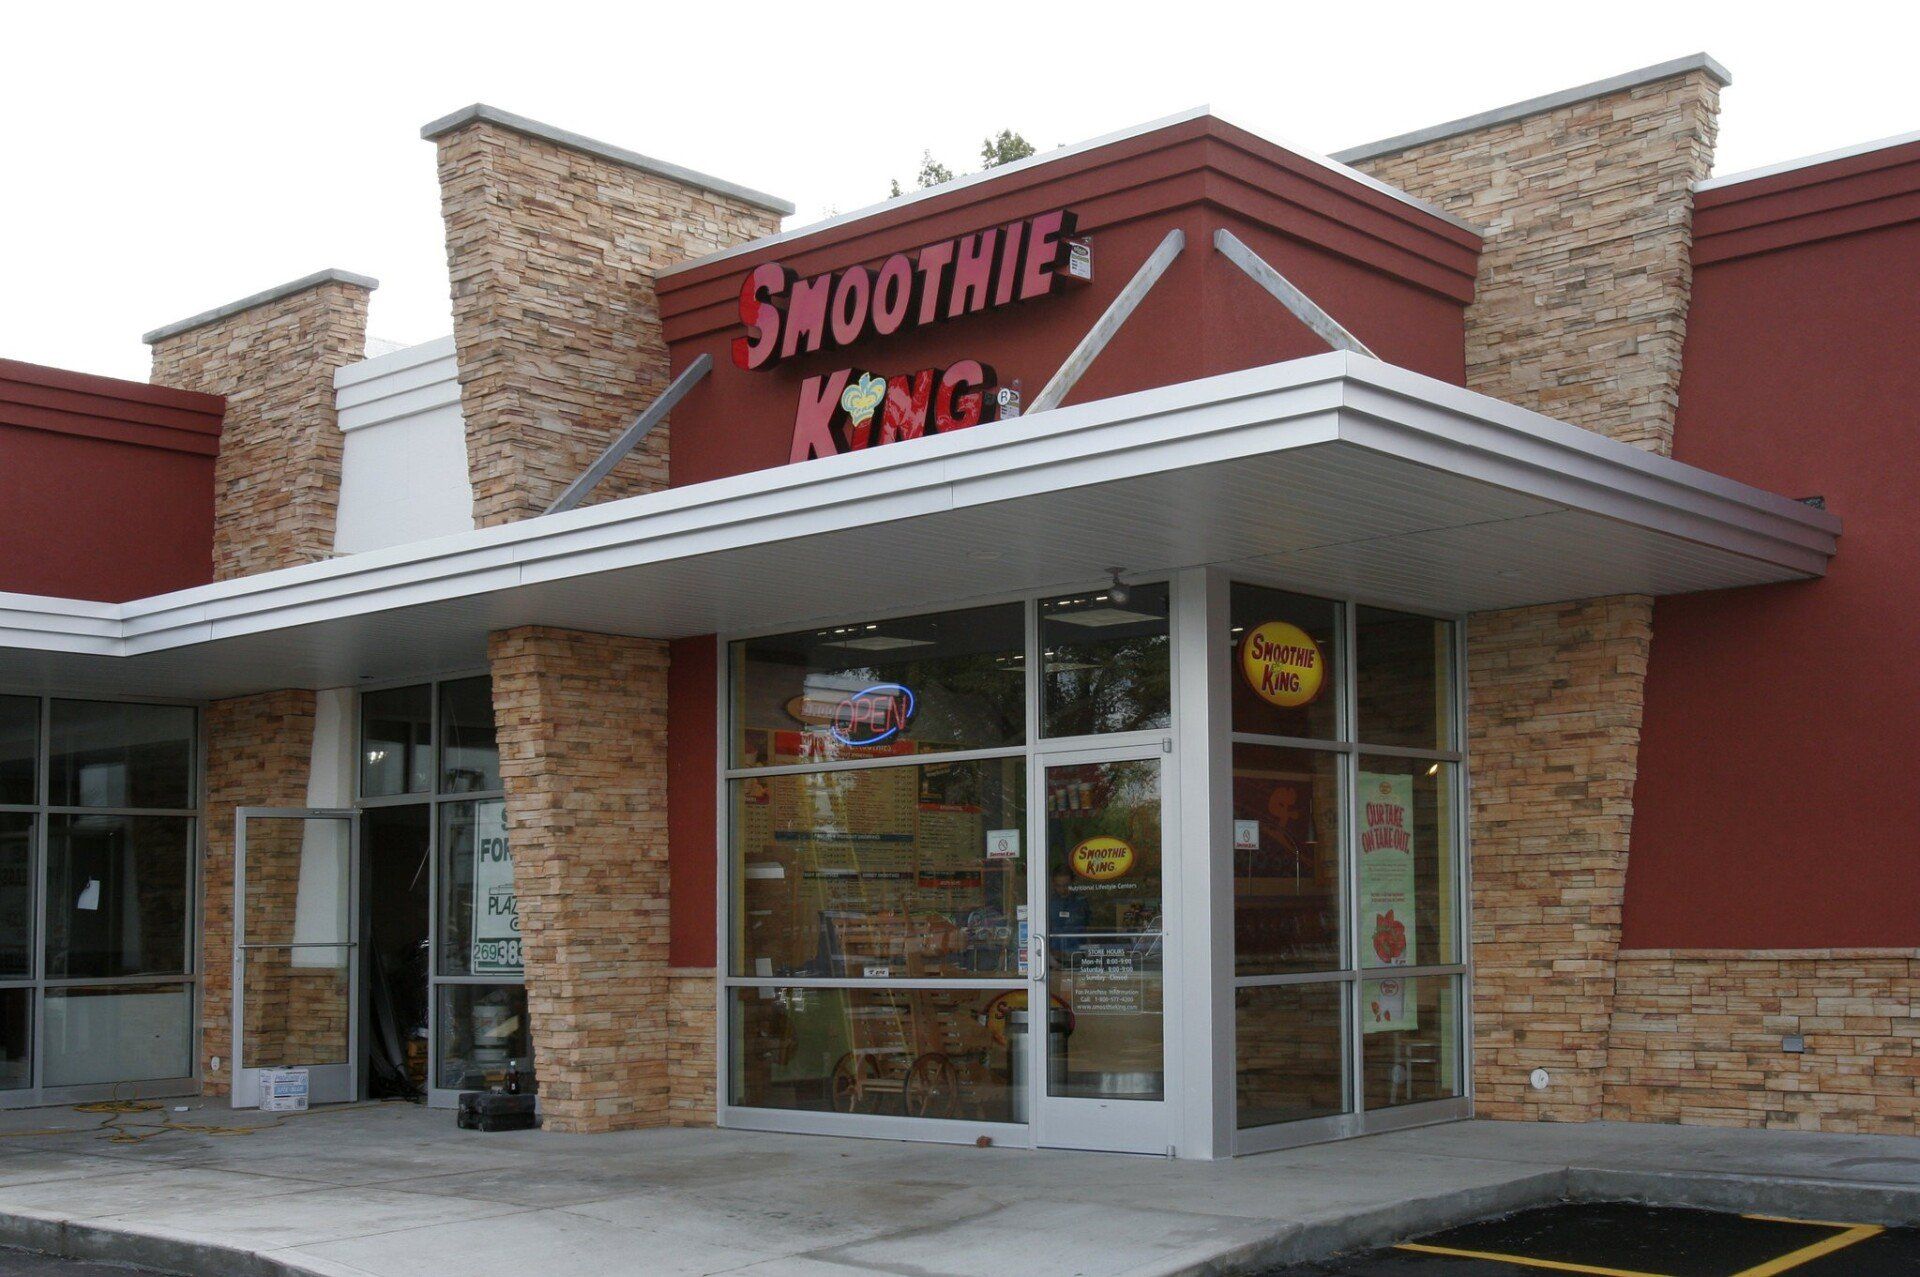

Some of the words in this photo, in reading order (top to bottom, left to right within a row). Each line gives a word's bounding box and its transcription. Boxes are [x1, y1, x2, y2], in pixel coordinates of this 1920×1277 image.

[731, 209, 1069, 371] SMOOTHIE
[789, 359, 987, 465] KING
[1251, 633, 1315, 669] SMOOTHIE
[1261, 664, 1299, 696] KING
[835, 695, 908, 735] OPEN
[1366, 802, 1385, 827] OUR
[1385, 804, 1405, 828] TAKE
[1078, 846, 1126, 860] SMOOTHIE
[1361, 830, 1375, 854] ON
[1086, 860, 1115, 875] KING
[1117, 882, 1138, 890] Centers
[474, 944, 497, 960] 269
